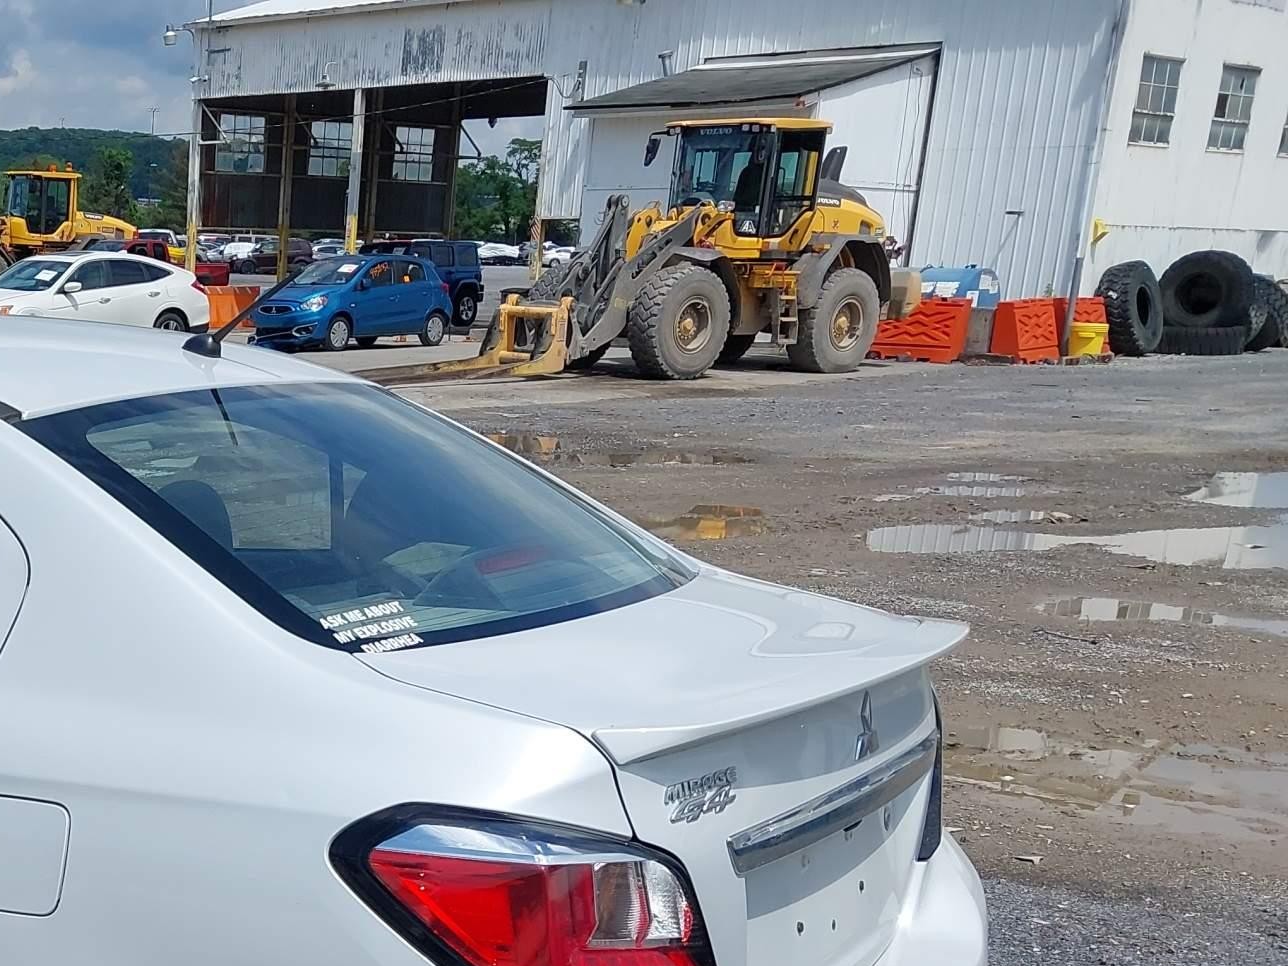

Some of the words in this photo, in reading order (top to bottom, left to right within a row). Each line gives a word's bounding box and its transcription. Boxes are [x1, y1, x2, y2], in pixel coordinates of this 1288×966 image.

[319, 613, 348, 630] ASK
[345, 609, 368, 623] ME
[364, 601, 405, 619] ABOUT
[333, 629, 357, 644] MY
[353, 616, 419, 639] EXPLOSIVE
[360, 632, 424, 654] DIARRHEA
[664, 766, 737, 806] MIRAGE
[670, 783, 737, 824] G4
